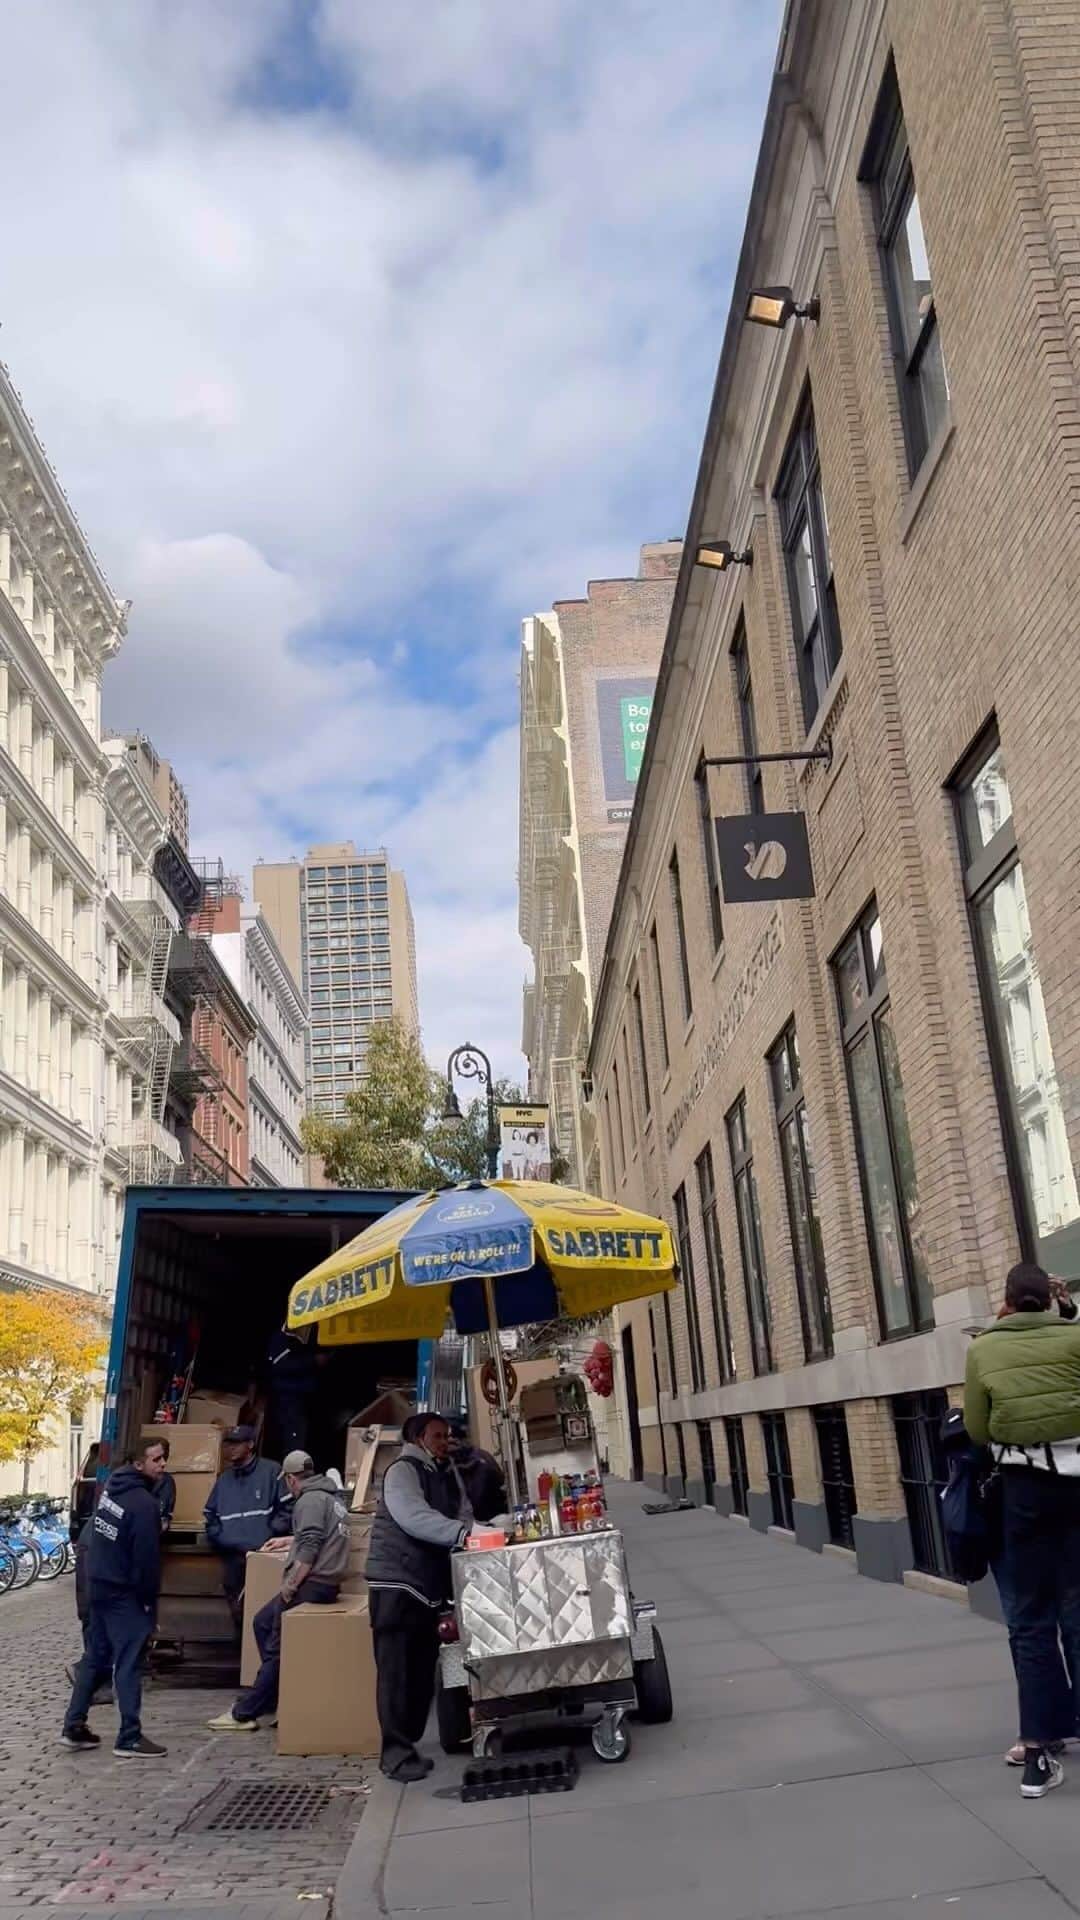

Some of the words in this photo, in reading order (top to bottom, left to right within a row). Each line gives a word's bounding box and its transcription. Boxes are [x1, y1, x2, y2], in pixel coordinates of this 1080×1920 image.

[469, 1250, 476, 1260] A
[478, 1246, 505, 1259] ROLL
[547, 1228, 663, 1259] SABRETT
[293, 1256, 394, 1316] SABRETT
